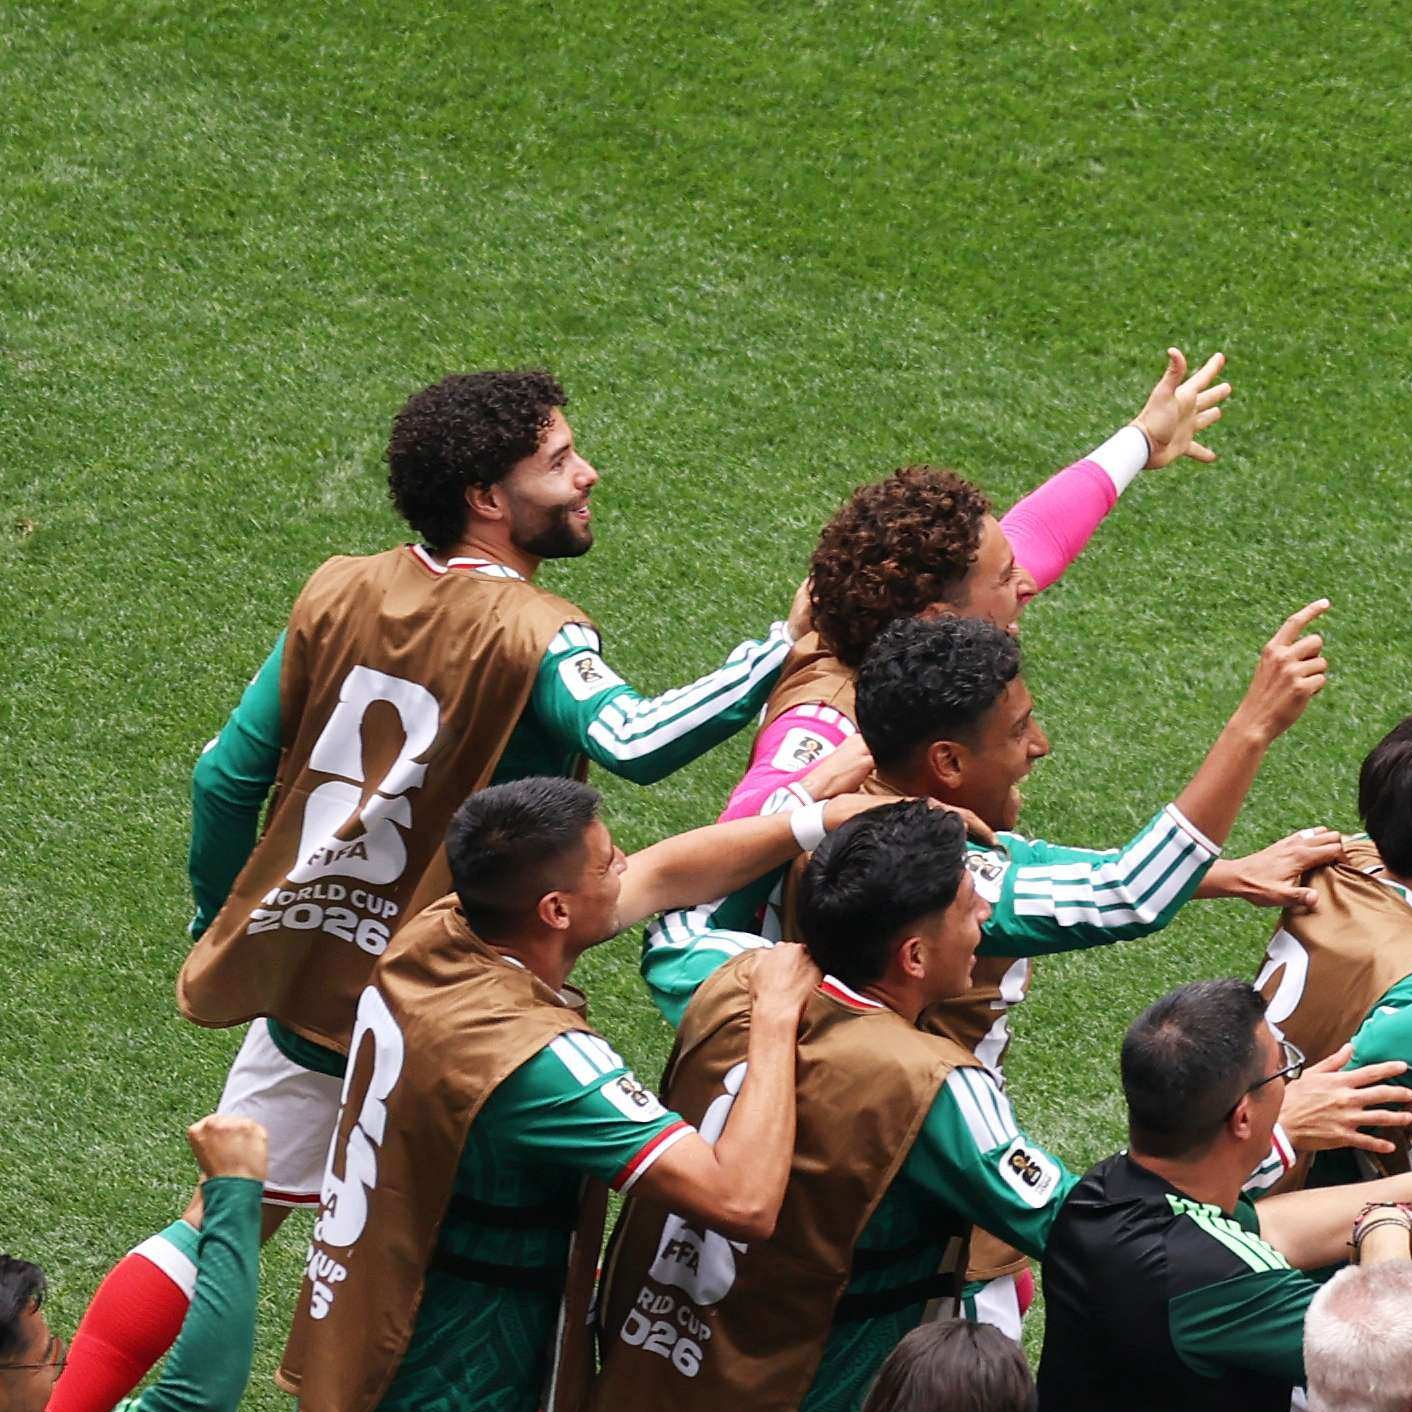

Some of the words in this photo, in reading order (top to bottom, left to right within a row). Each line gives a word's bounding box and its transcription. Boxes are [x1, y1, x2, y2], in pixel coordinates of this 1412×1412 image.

[308, 840, 369, 867] FIFA
[350, 888, 398, 919] CUP
[247, 902, 391, 956] 2026
[677, 1305, 711, 1341] CUP
[620, 1308, 703, 1377] 026
